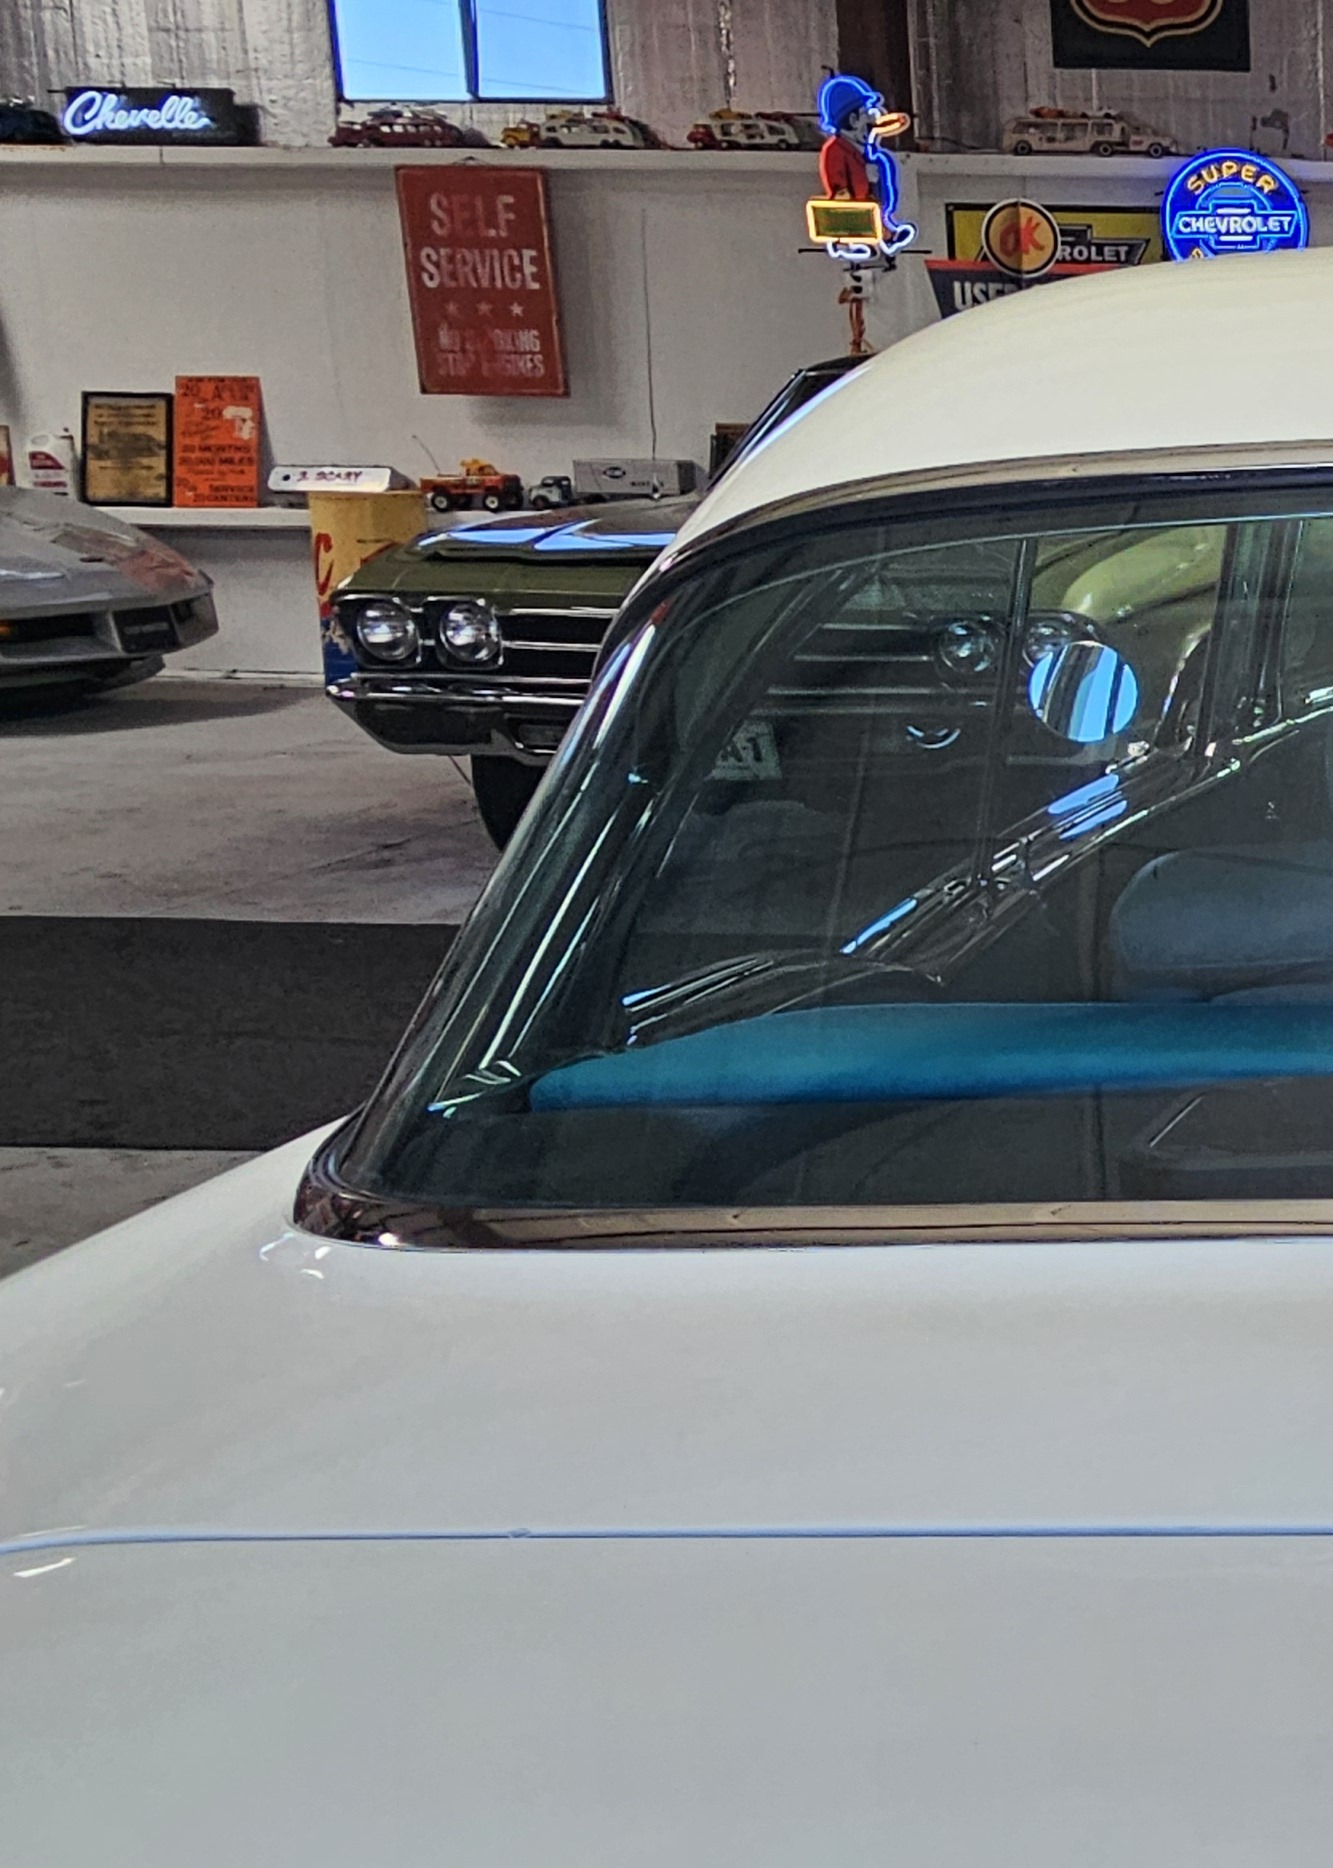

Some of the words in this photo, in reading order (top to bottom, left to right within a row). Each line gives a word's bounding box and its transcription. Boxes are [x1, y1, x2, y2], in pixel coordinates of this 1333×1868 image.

[64, 91, 215, 135] Chevelle
[1187, 161, 1279, 195] SUPER
[430, 191, 516, 238] SELF
[1178, 215, 1292, 234] CHEVROLET
[999, 215, 1045, 258] OK
[1057, 245, 1130, 262] ROLET
[420, 246, 541, 290] SERVICE
